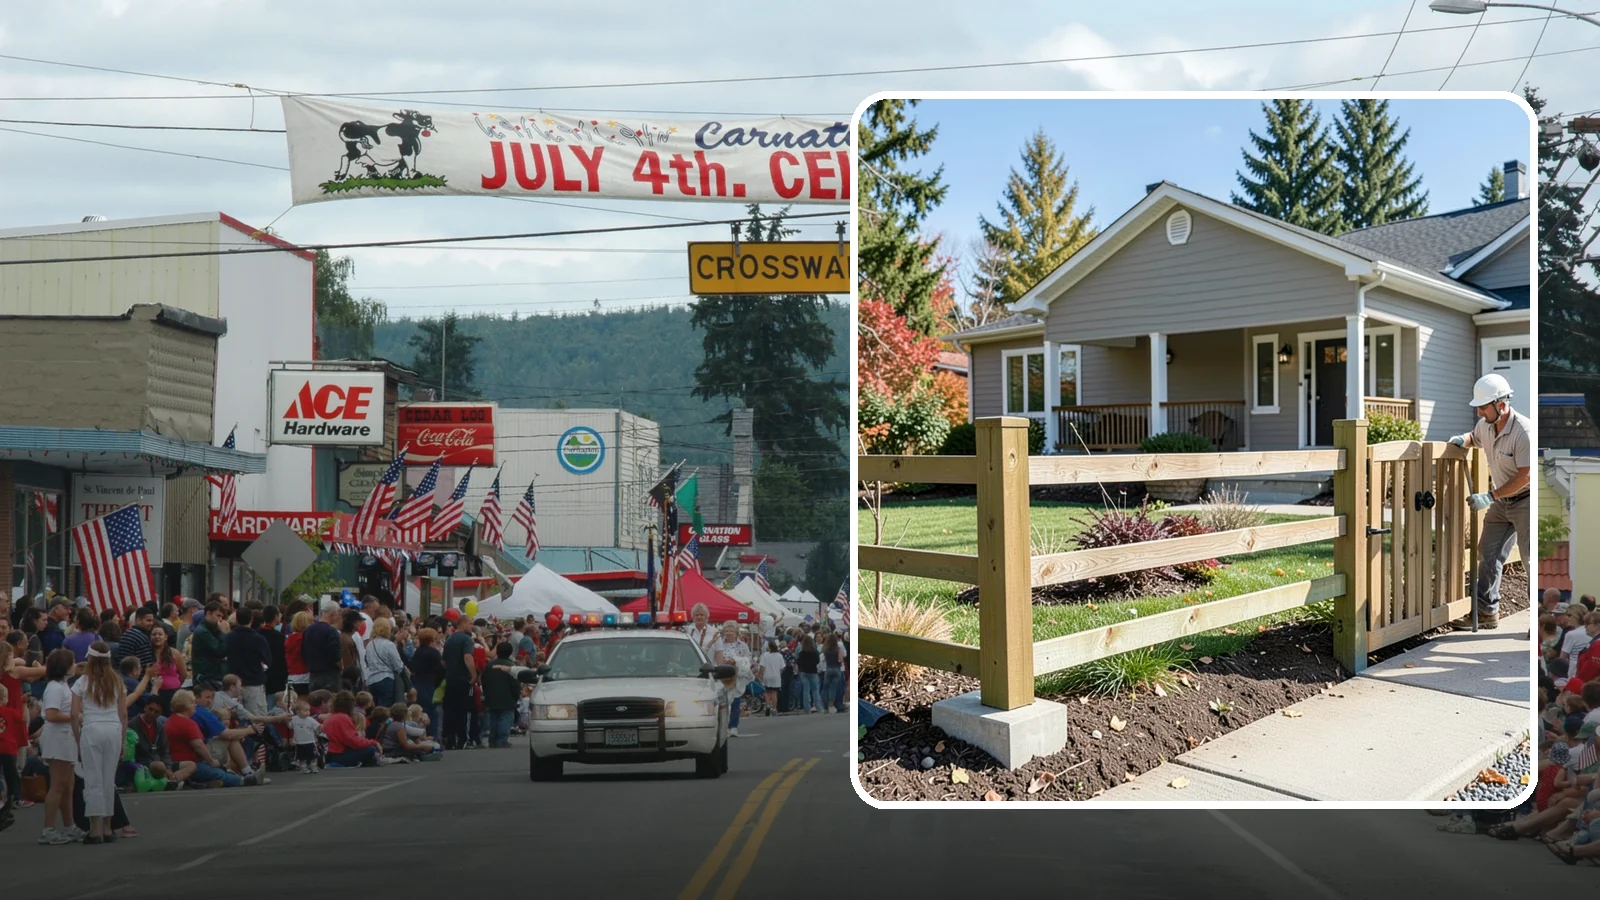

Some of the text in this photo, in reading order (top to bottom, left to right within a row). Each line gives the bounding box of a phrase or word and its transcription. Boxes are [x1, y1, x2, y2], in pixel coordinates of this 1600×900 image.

[481, 141, 605, 193] JULY
[632, 149, 747, 198] 4th.
[696, 254, 850, 280] CROSSWA
[283, 380, 373, 420] ACE
[405, 409, 452, 422] CEDAR
[284, 421, 371, 436] Hardware
[416, 428, 477, 447] Coca-Cola
[353, 467, 385, 481] Simpl
[96, 485, 124, 495] Vincent
[126, 486, 136, 495] de
[137, 485, 155, 495] Paul
[688, 526, 741, 535] CRNATION
[699, 535, 730, 543] GLASS
